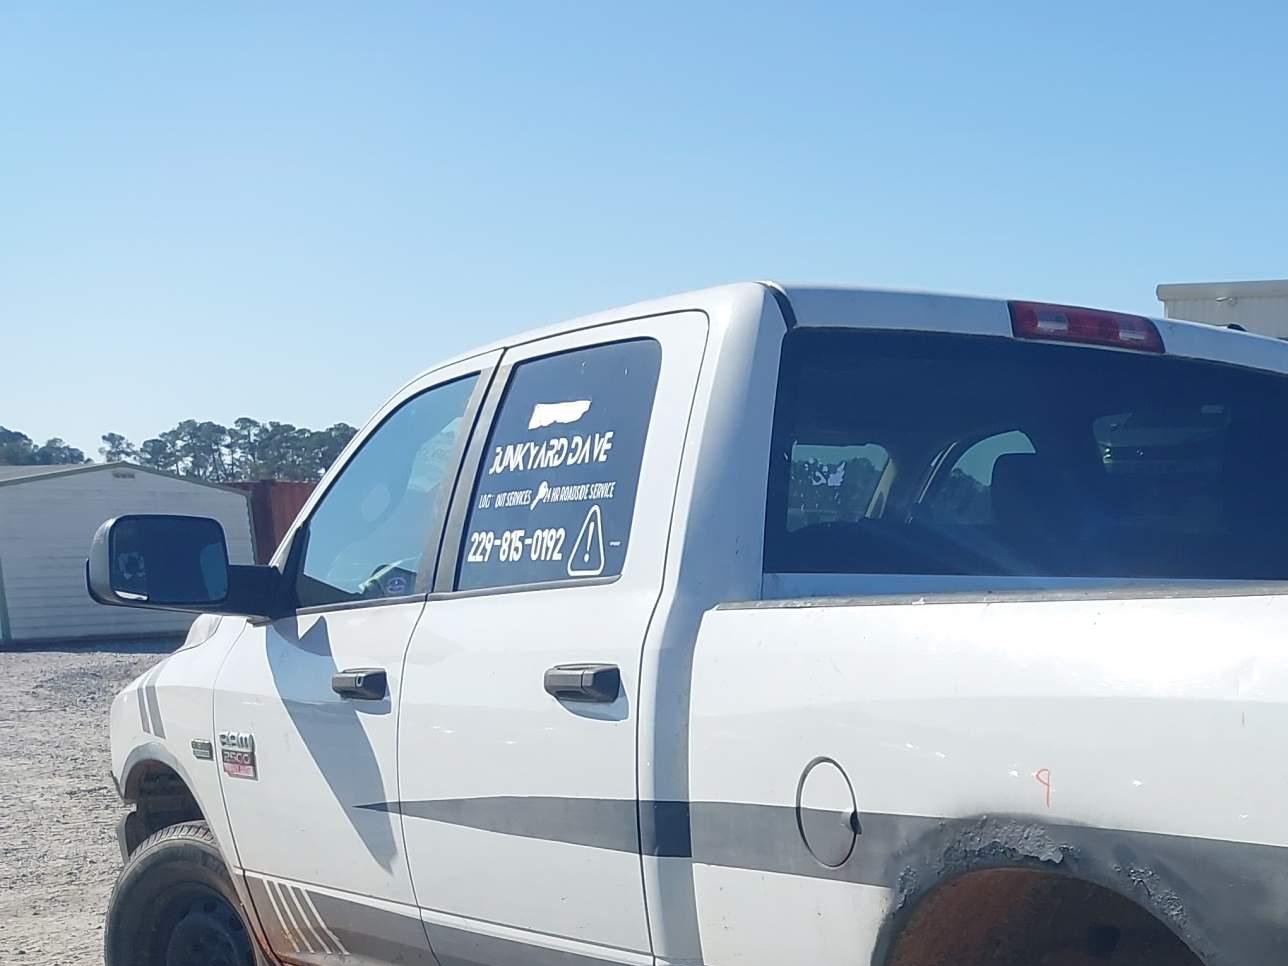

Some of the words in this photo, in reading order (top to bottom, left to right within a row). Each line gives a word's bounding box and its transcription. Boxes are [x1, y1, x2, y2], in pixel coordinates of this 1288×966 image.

[489, 437, 568, 475] JUNKYARD
[566, 431, 614, 466] DAVE
[560, 483, 590, 501] ROADSIDE
[589, 481, 617, 499] SERVICE
[467, 527, 566, 562] 229-815-0192
[223, 751, 251, 764] 2500
